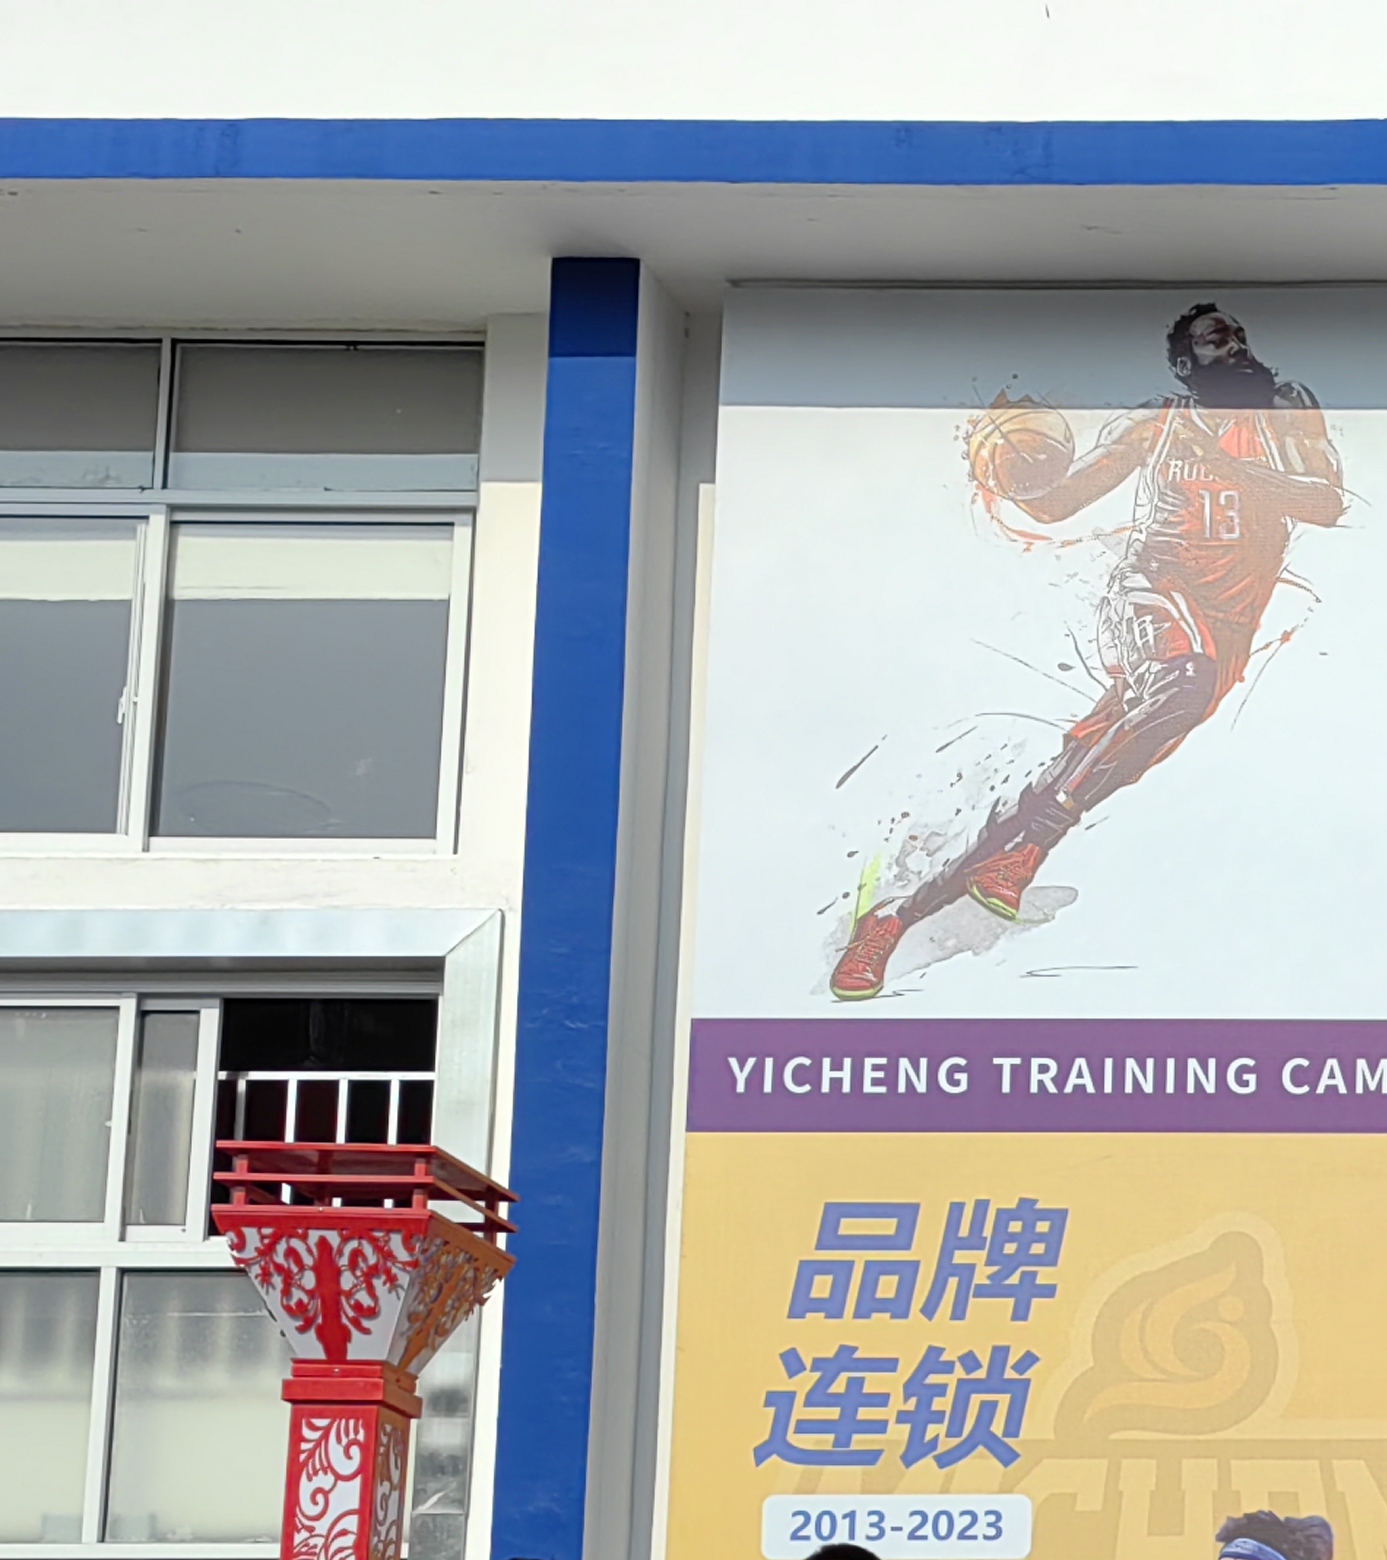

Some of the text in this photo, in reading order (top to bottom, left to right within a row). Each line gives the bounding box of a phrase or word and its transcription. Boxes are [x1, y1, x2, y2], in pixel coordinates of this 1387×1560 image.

[1199, 489, 1241, 540] 13
[727, 1056, 969, 1095] YICHENG
[992, 1057, 1259, 1095] TRAINING
[787, 1197, 1069, 1323] 品牌
[753, 1343, 1040, 1471] 连锁
[788, 1508, 1005, 1544] 2013-2023
